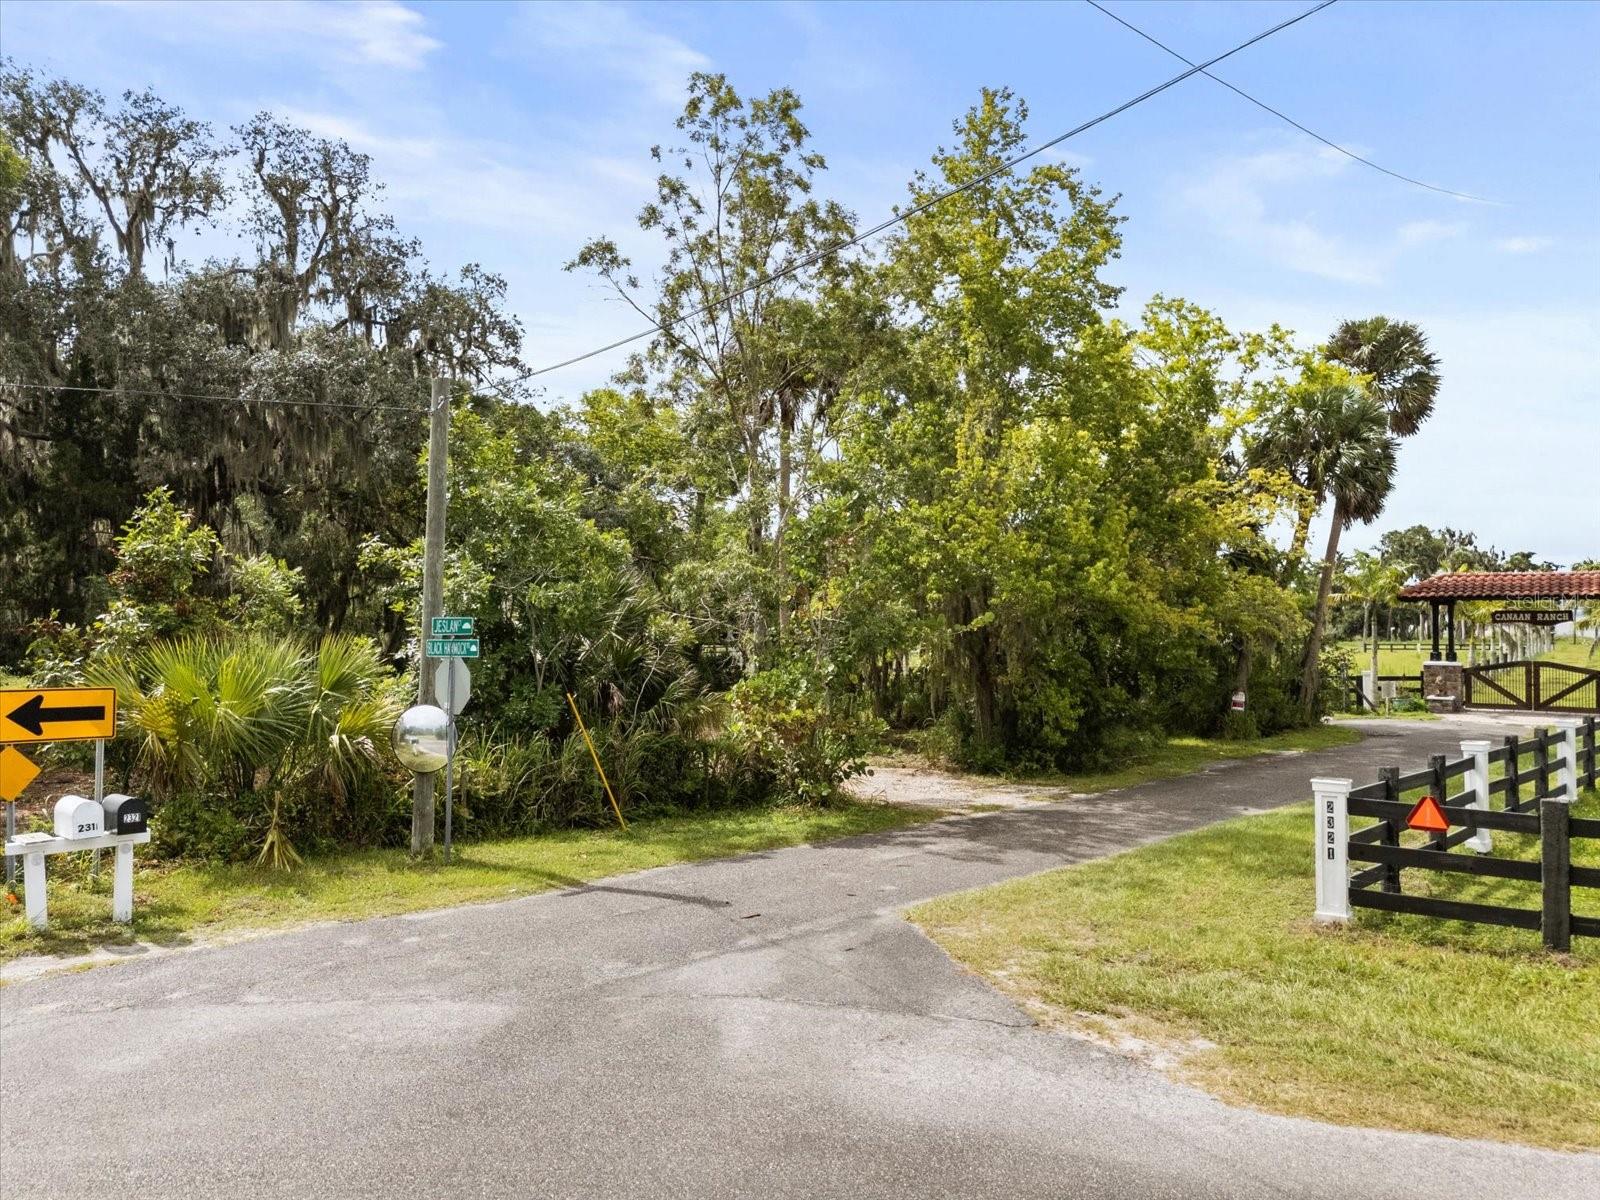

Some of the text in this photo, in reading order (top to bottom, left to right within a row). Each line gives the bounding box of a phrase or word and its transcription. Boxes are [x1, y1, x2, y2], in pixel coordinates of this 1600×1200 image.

[1494, 613, 1569, 621] CANAAN RANCH
[434, 620, 458, 632] JESLAN
[428, 642, 442, 654] BLACK
